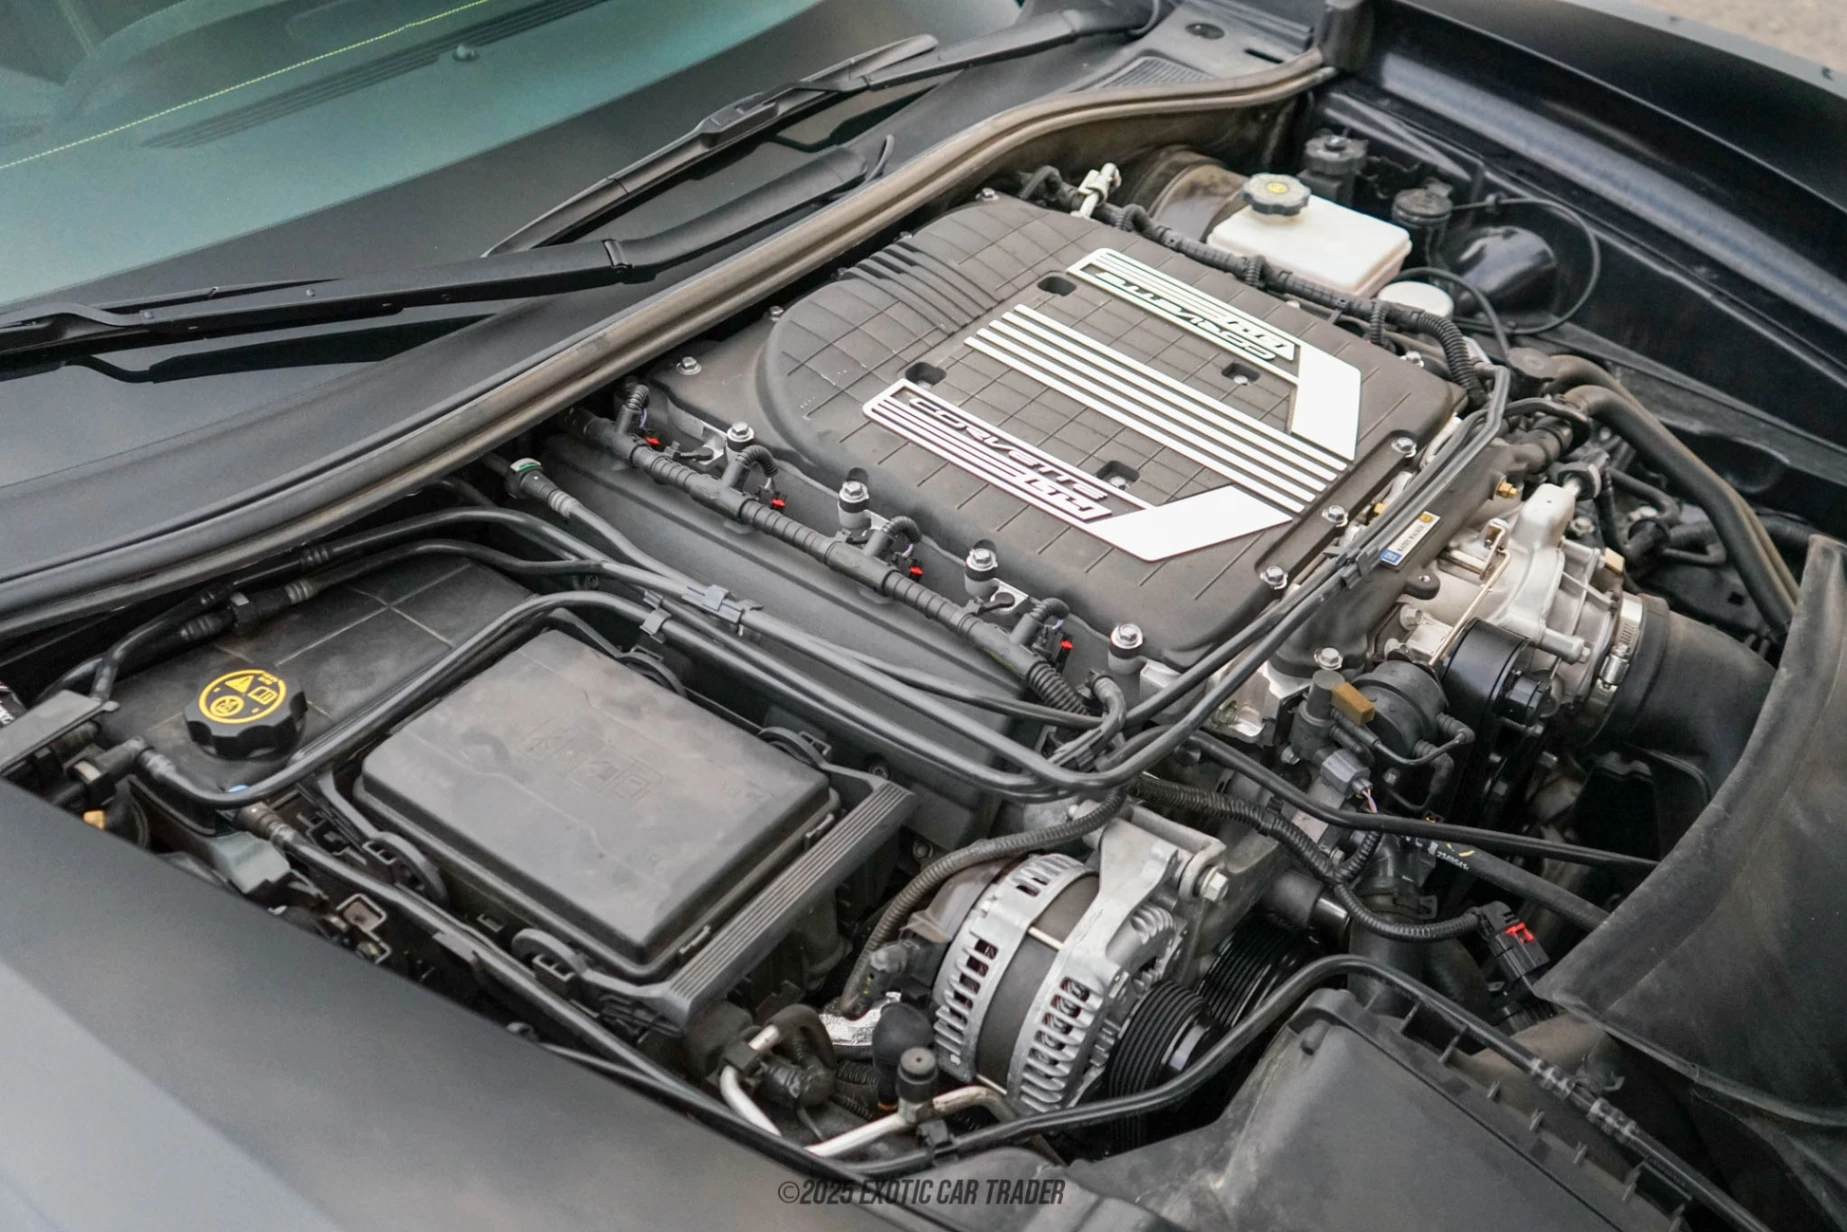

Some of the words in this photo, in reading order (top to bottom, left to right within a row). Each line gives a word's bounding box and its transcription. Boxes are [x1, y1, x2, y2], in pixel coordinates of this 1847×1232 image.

[1094, 271, 1276, 361] CORVETTE
[908, 397, 1109, 501] CORVETTE
[1024, 477, 1095, 512] LT4
